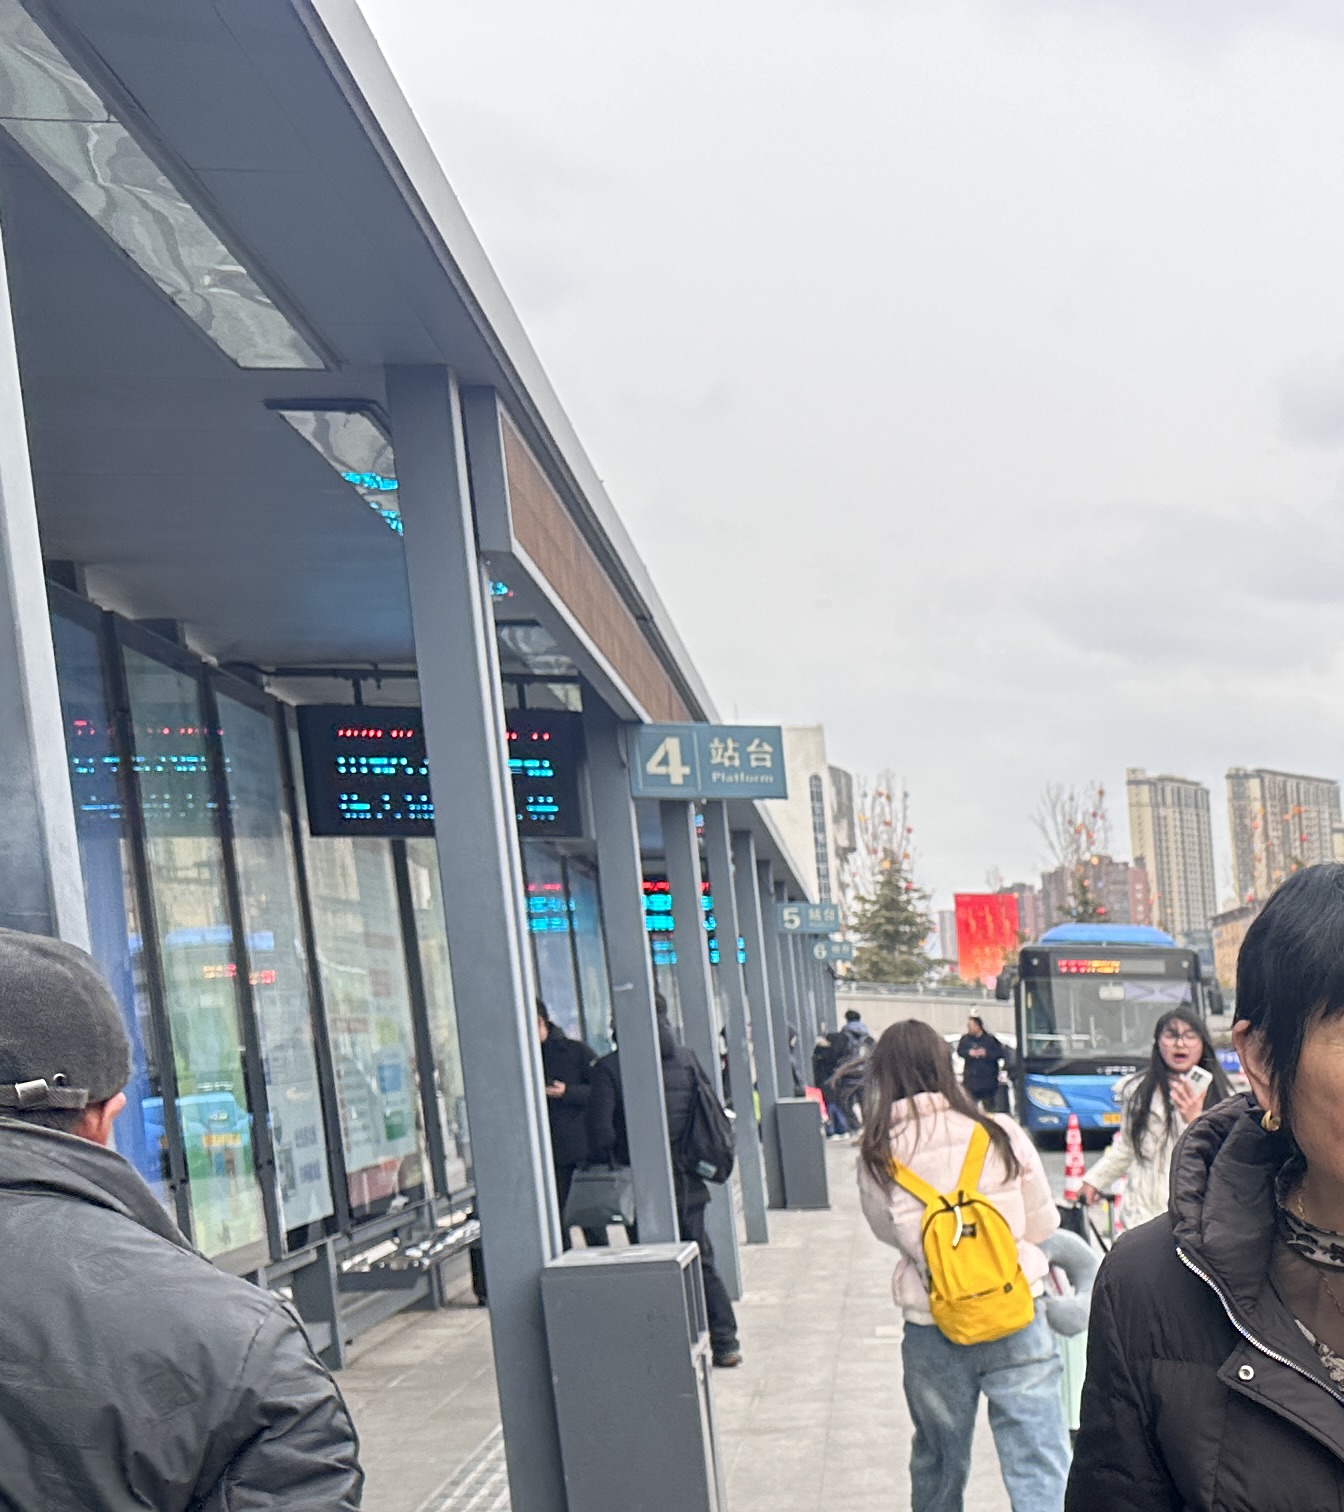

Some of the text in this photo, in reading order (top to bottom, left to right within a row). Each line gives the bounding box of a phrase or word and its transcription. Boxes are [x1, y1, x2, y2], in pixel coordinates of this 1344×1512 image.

[645, 736, 691, 786] 4
[709, 736, 773, 768] 站台
[711, 772, 774, 784] Platform
[782, 907, 801, 930] 5
